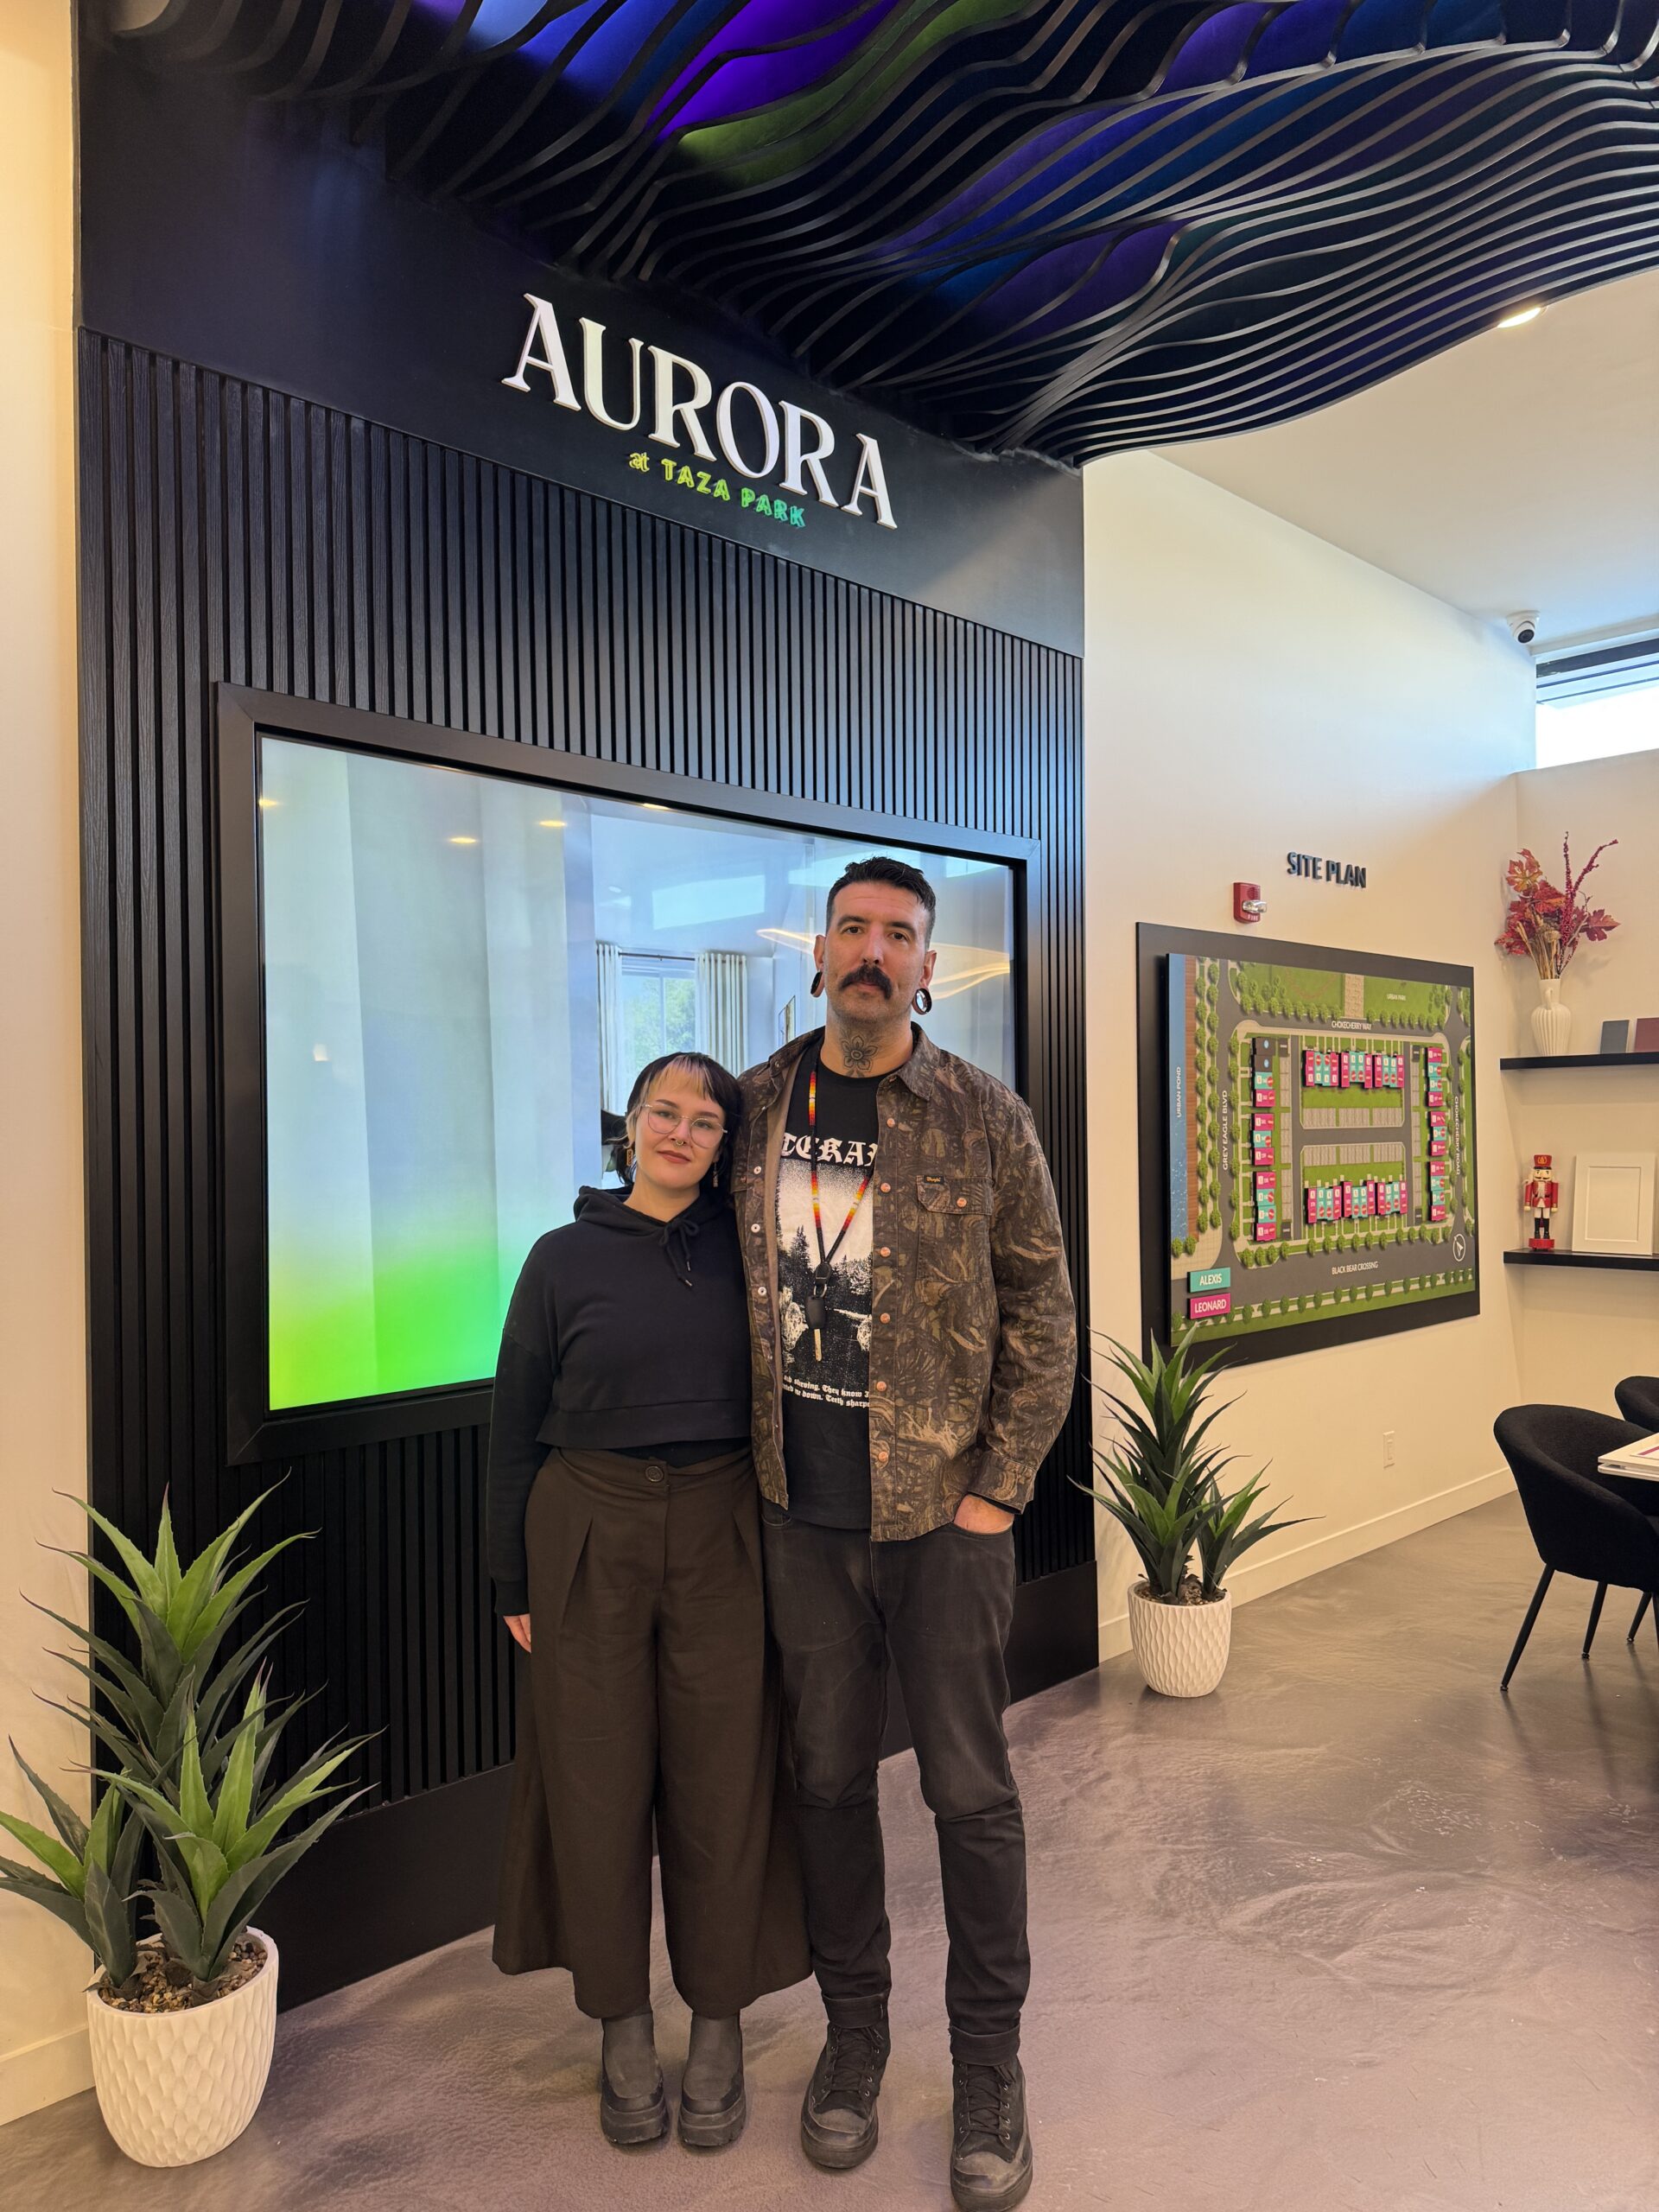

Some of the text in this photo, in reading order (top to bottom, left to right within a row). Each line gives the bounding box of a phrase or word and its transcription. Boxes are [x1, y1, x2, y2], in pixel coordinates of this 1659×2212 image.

[501, 293, 898, 530] AURORA
[629, 452, 806, 529] at TAZA PARK
[1287, 851, 1367, 888] SITE PLAN
[1332, 1020, 1362, 1030] CHOKECHERRY
[1332, 1261, 1379, 1275] BLACK BEAR CROSSING
[1199, 1273, 1223, 1287] ALEXIS
[1194, 1298, 1227, 1314] LEONARD
